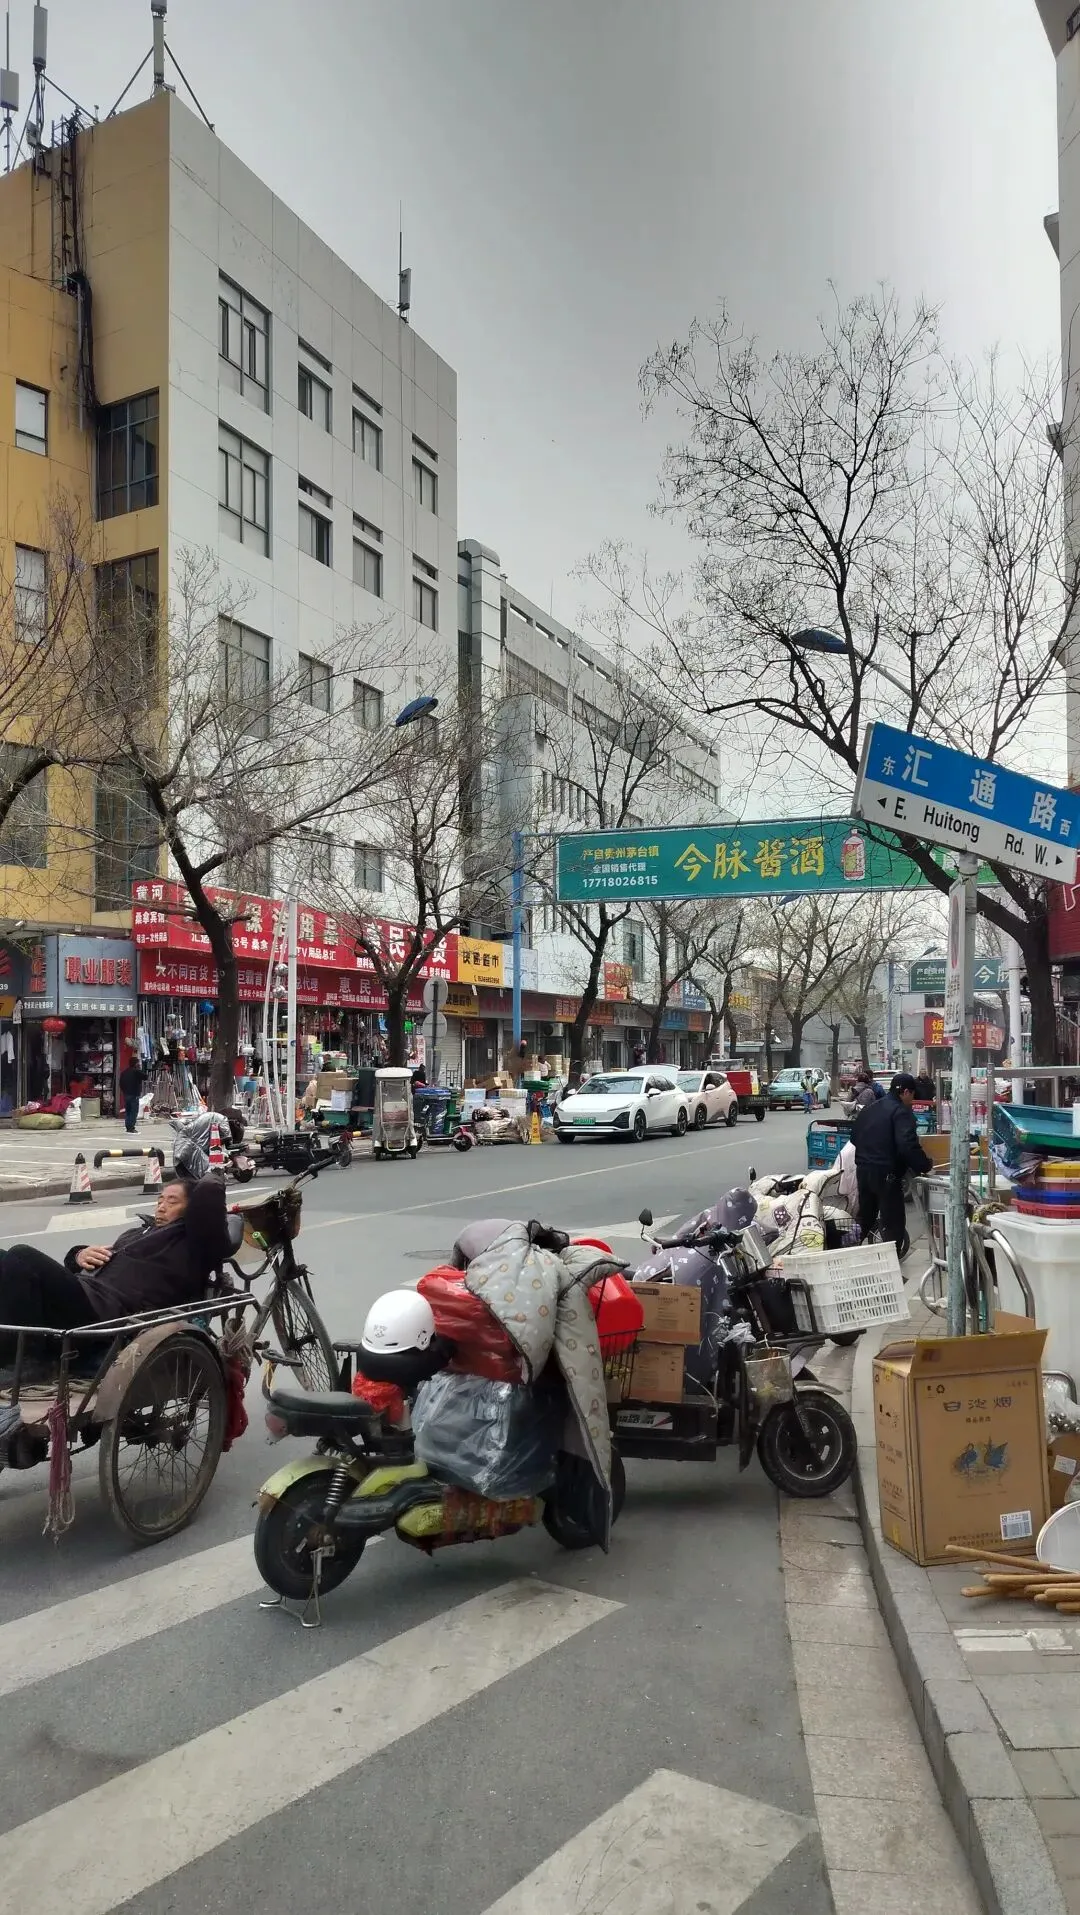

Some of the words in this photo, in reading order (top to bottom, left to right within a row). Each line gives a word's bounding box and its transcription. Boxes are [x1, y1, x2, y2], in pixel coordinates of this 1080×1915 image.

[881, 756, 896, 776] 东
[1060, 818, 1072, 837] 西
[893, 796, 907, 820] E.
[923, 804, 980, 843] Huitong
[1004, 833, 1025, 856] Rd.
[1035, 843, 1049, 867] W.
[674, 836, 825, 882] 今脉酱酒
[582, 875, 658, 888] 17718026815
[65, 956, 131, 986] 职业服装
[65, 1002, 134, 1013] 专注团体服装定制
